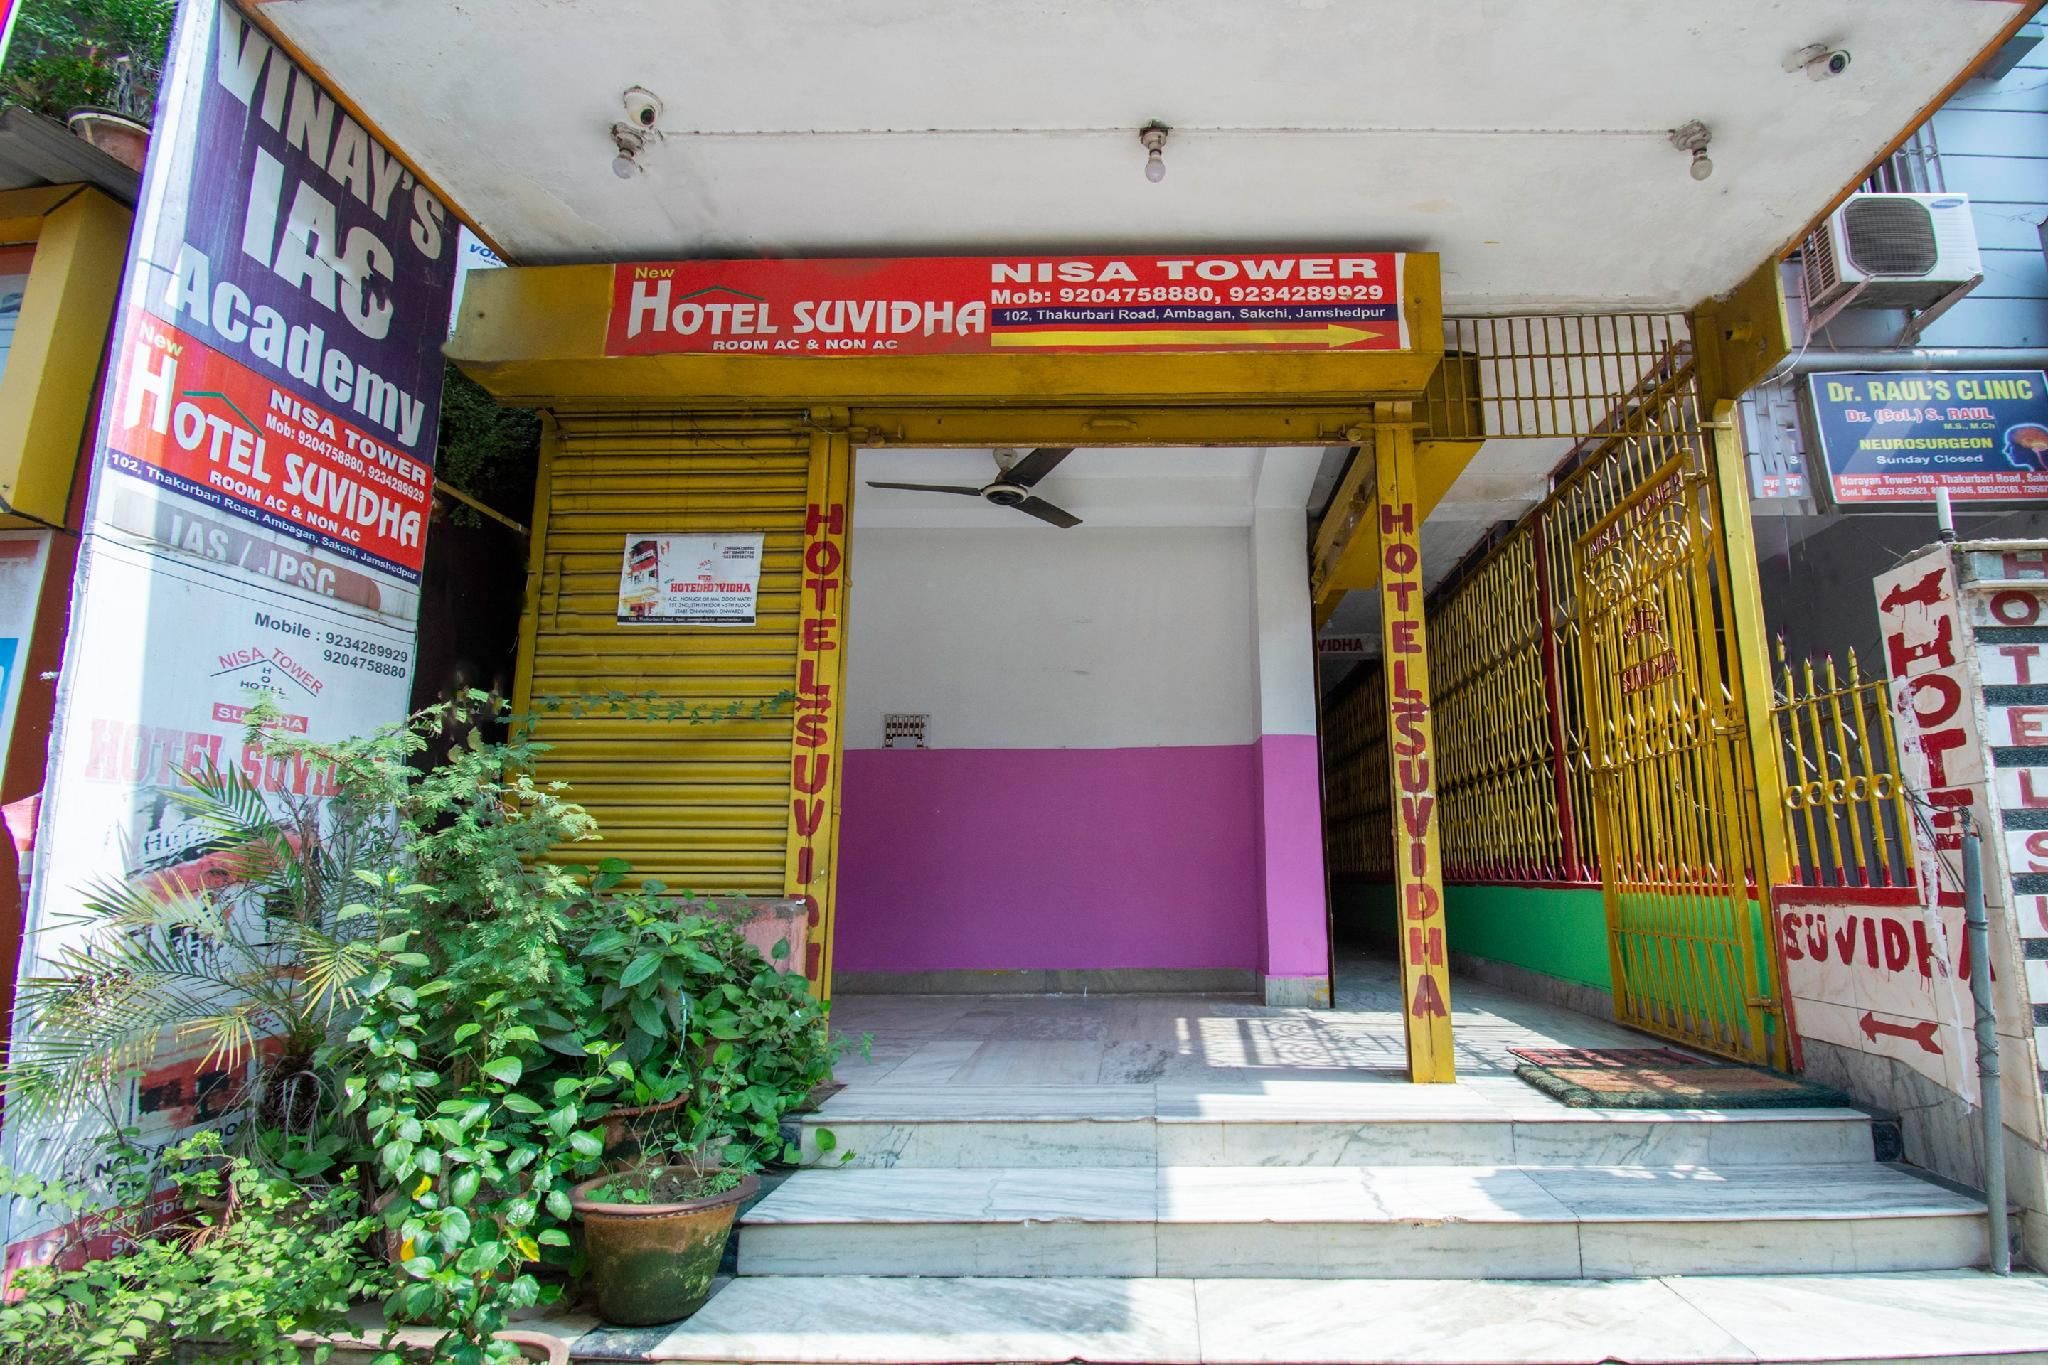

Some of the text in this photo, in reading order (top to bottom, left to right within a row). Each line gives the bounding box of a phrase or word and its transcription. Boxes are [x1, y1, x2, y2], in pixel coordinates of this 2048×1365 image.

[218, 2, 444, 260] VINAY'S
[634, 266, 675, 279] New
[990, 258, 1379, 284] NISA TOWER
[990, 285, 1384, 306] Mob: 9204758880, 9234289929
[627, 280, 987, 339] HOTEL SUVIDHA
[1003, 305, 1386, 324] 102, Thakurbari Road, Ambagan, Sakchi, Jamshedpur
[139, 322, 184, 357] New
[165, 242, 425, 447] Academy
[712, 338, 899, 351] ROOM AC & NON AC
[1828, 378, 2034, 402] Dr. RAUL'S CLINIC
[270, 389, 426, 487] NISA TOWER
[1845, 407, 1994, 424] Dr. (Col.) S. RAUL
[123, 340, 421, 548] HOTEL SUVIDHA
[266, 412, 425, 504] Mob: 9204758880, 9234289929
[1859, 437, 1994, 451] NEUROSURGEON
[1876, 453, 1984, 467] Sunday Closed
[111, 453, 418, 580] 102, Thakurbari Road, Ambagan, Sakchi, Jamshedpur
[209, 470, 362, 542] ROOM AC & NON AC
[170, 513, 229, 563] IAS
[798, 503, 844, 695] HOTEL
[1381, 503, 1423, 699] HOTEL
[254, 612, 311, 639] Mobile
[325, 632, 408, 663] 9234289929
[218, 646, 324, 695] NISA TOWER
[323, 649, 406, 679] 9204758880
[1394, 711, 1448, 1019] SUVIDHA
